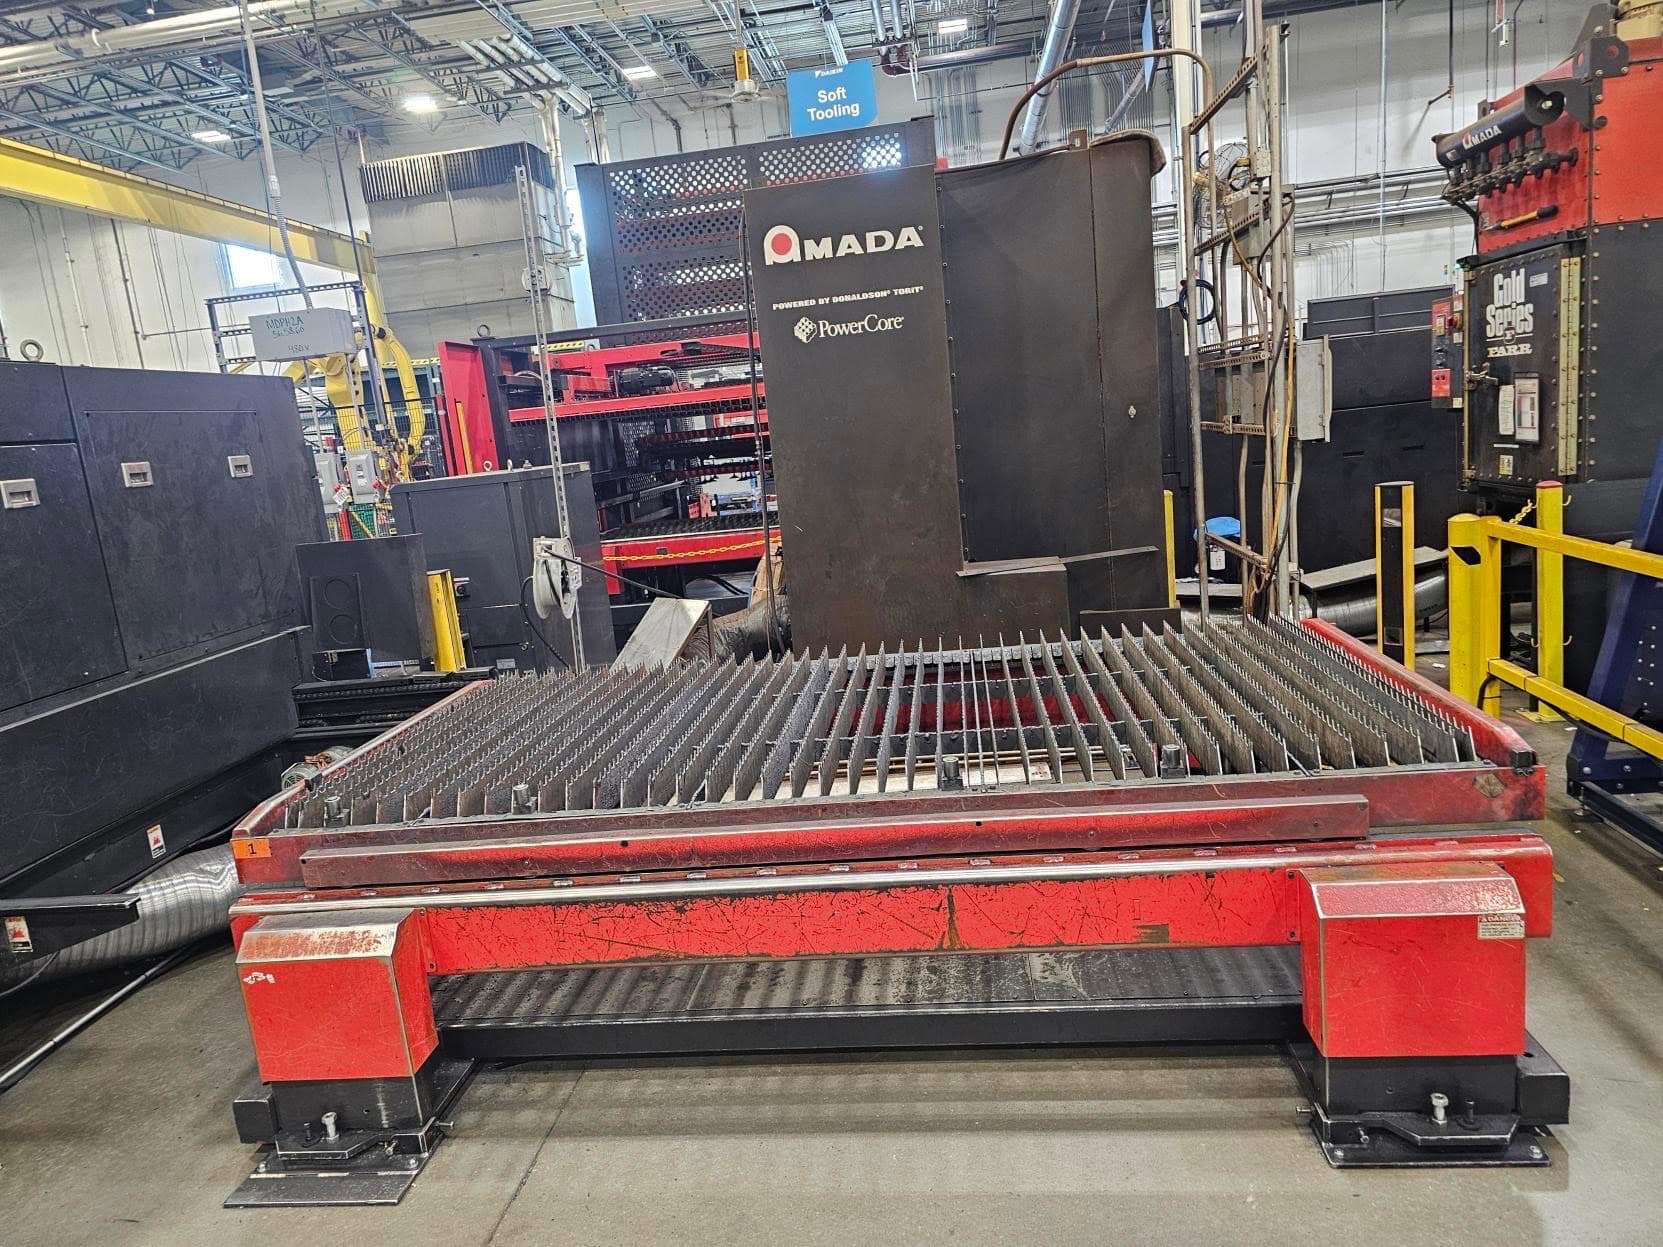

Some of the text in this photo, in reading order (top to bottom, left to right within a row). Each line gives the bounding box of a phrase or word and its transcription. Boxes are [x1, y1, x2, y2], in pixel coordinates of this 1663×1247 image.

[817, 86, 847, 103] Soft
[807, 102, 860, 121] Tooling
[772, 299, 816, 310] POWERED
[818, 297, 830, 305] BY
[1486, 303, 1534, 338] Series
[1487, 343, 1532, 358] FARR
[247, 843, 257, 855] 1
